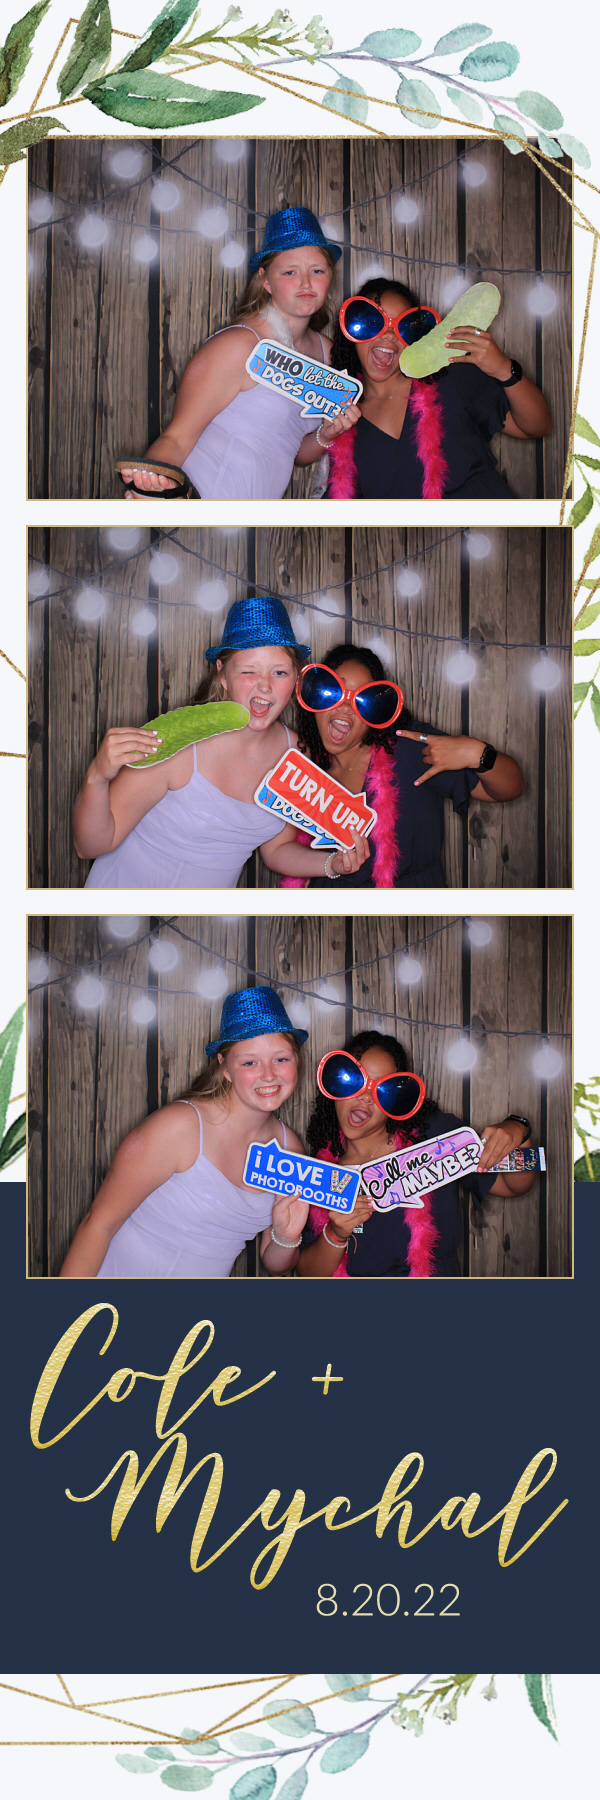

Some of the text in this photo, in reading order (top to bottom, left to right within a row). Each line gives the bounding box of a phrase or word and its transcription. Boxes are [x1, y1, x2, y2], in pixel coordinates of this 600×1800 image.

[261, 365, 305, 397] DOGS
[263, 347, 345, 391] WHO let the
[279, 760, 334, 814] TURN
[250, 1171, 349, 1210] PHOTOBOOTHS
[266, 1154, 324, 1186] LOVE
[368, 1151, 433, 1200] Call me
[400, 1143, 482, 1198] MAYBE?
